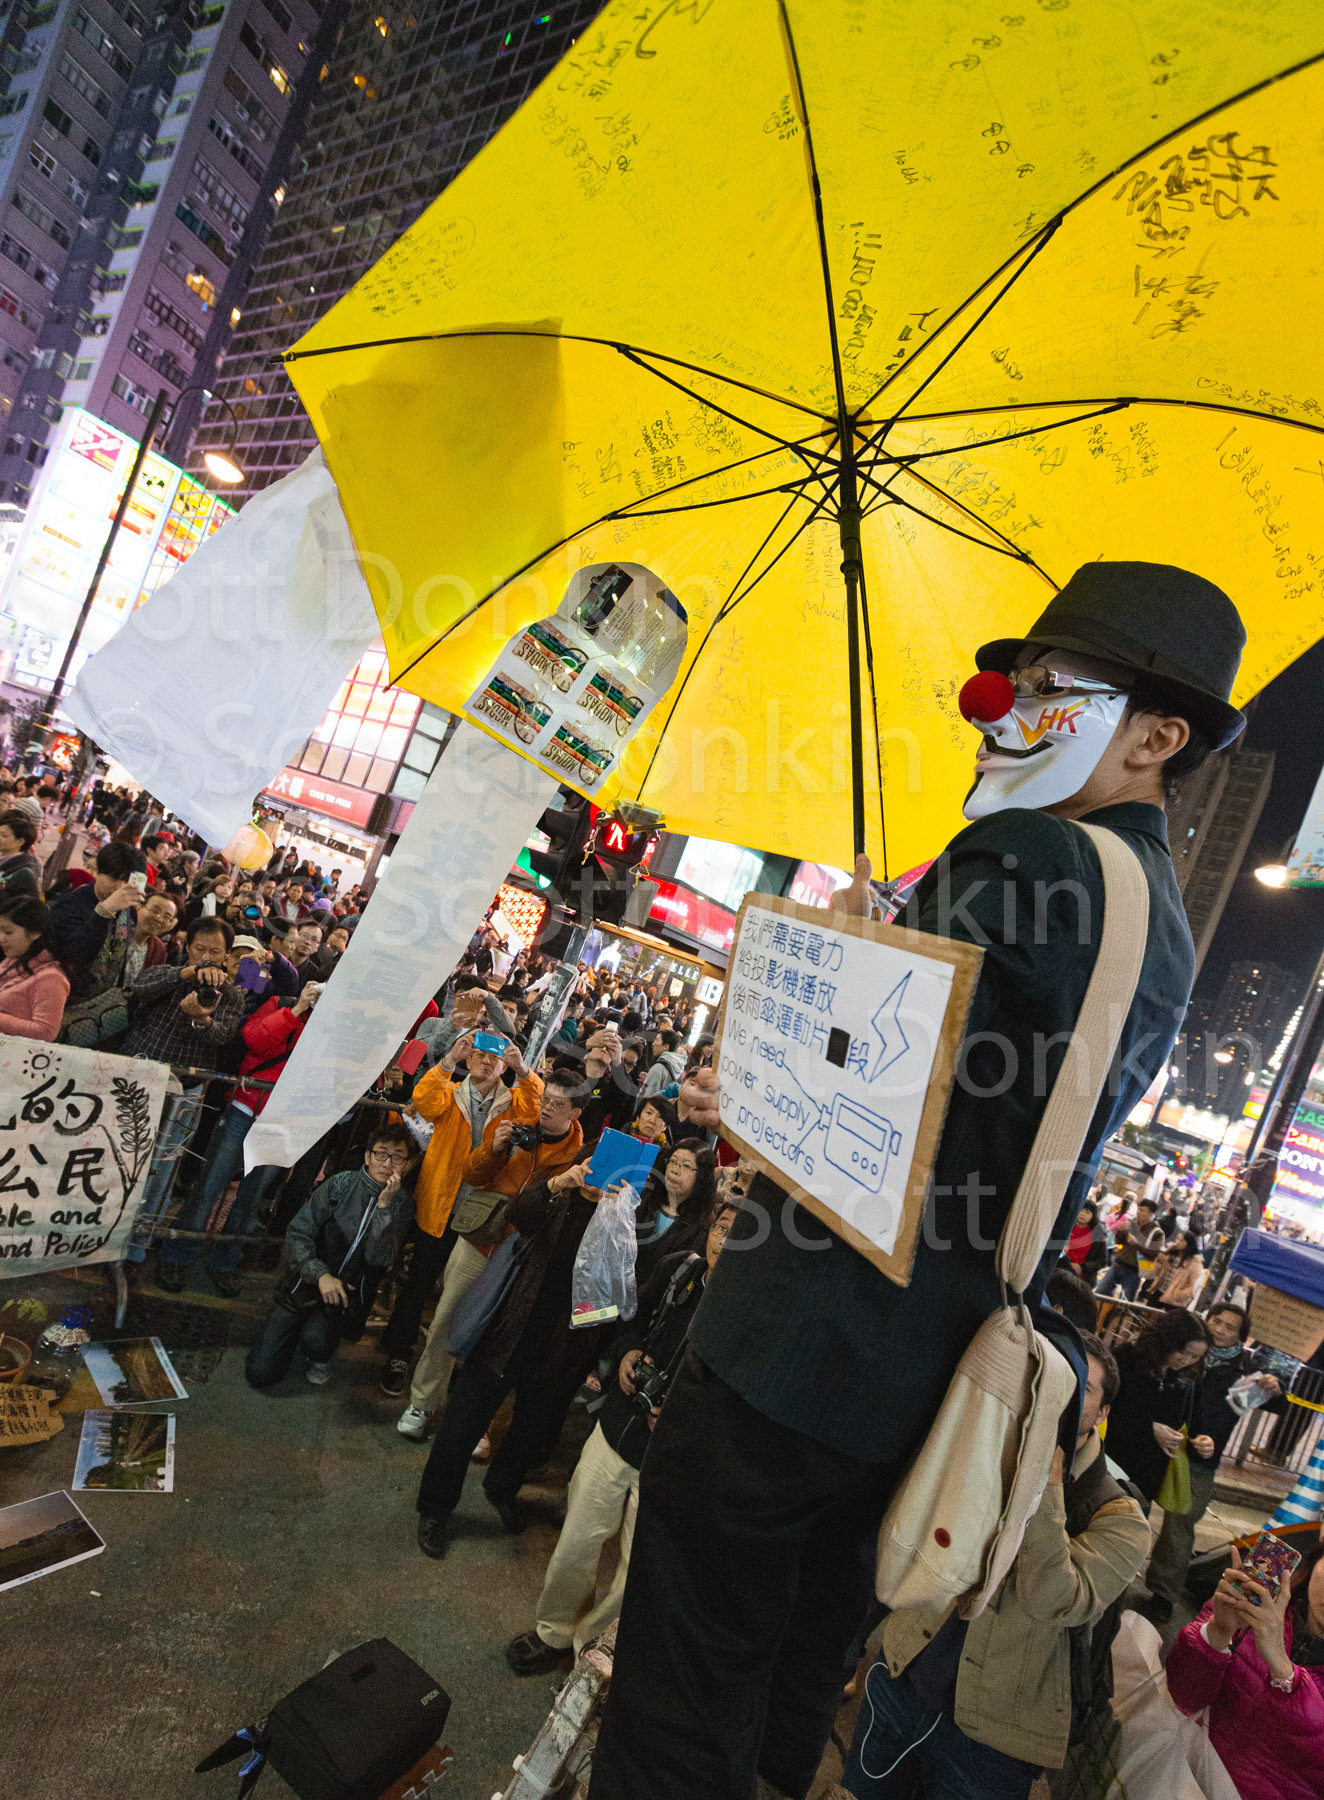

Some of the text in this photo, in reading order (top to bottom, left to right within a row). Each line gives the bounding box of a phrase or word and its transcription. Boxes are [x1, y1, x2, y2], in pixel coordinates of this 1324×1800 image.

[1037, 708, 1085, 735] HK
[744, 913, 844, 973] 我們需要電力
[736, 950, 838, 1017] 給投影機播放
[727, 1018, 747, 1046] We
[751, 1035, 787, 1068] need
[721, 1054, 811, 1129] power supply
[737, 1106, 815, 1176] projectors
[50, 1206, 103, 1228] and
[45, 1231, 108, 1259] Policy
[420, 1689, 441, 1707] EPSON
